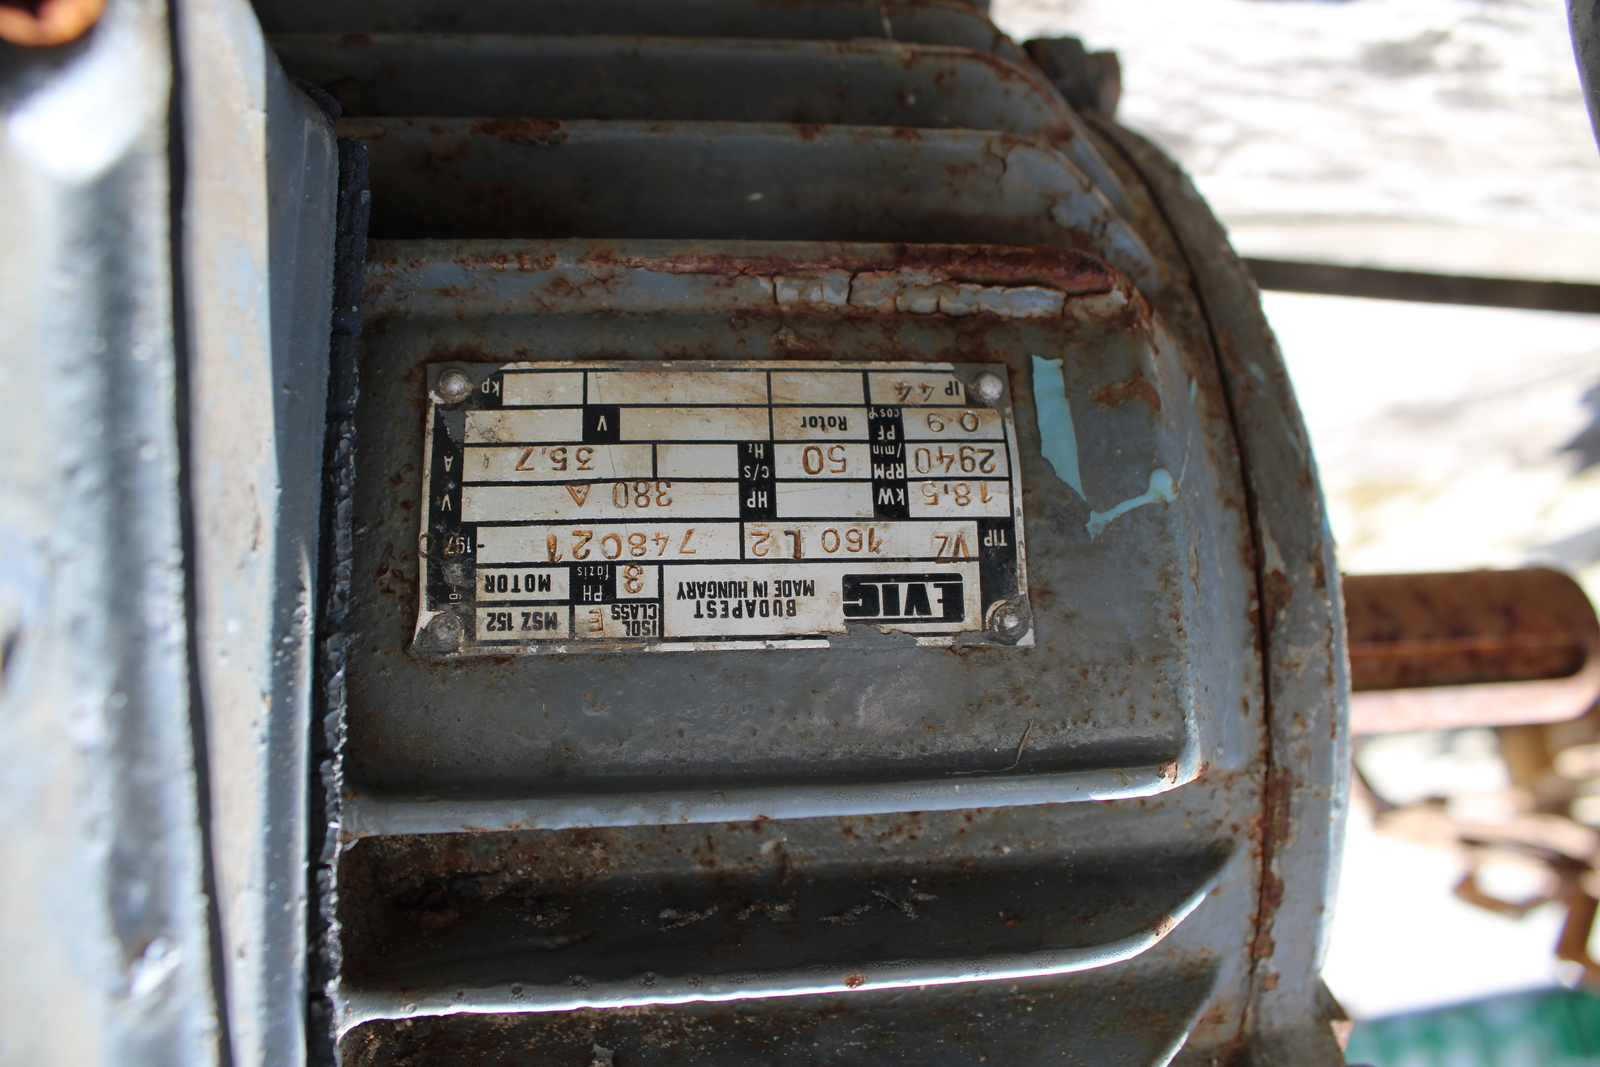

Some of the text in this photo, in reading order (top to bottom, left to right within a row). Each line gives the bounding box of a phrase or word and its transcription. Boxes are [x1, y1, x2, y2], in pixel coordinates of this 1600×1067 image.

[482, 378, 499, 396] kp
[894, 381, 959, 401] IP 44
[597, 415, 608, 431] V
[800, 416, 847, 431] Rotor
[878, 425, 895, 439] PF
[748, 443, 763, 458] Hz
[873, 444, 901, 457] /min
[444, 456, 453, 471] A
[802, 445, 847, 475] 50
[914, 446, 996, 475] 2940
[873, 463, 904, 479] RPM
[441, 494, 452, 511] V
[612, 480, 673, 509] 380
[747, 491, 767, 507] HP
[878, 488, 904, 505] kW
[546, 529, 697, 563] 748021
[821, 527, 882, 554] 160
[984, 529, 1007, 547] TIP
[485, 574, 550, 593] MOTOR
[676, 580, 814, 599] MADE IN HUNGARY
[583, 585, 602, 601] PH
[611, 604, 657, 620] CLASS
[693, 599, 796, 618] BUDAPEST
[486, 612, 558, 631] MSZ 152
[589, 609, 603, 632] E
[622, 620, 657, 636] ISOL
